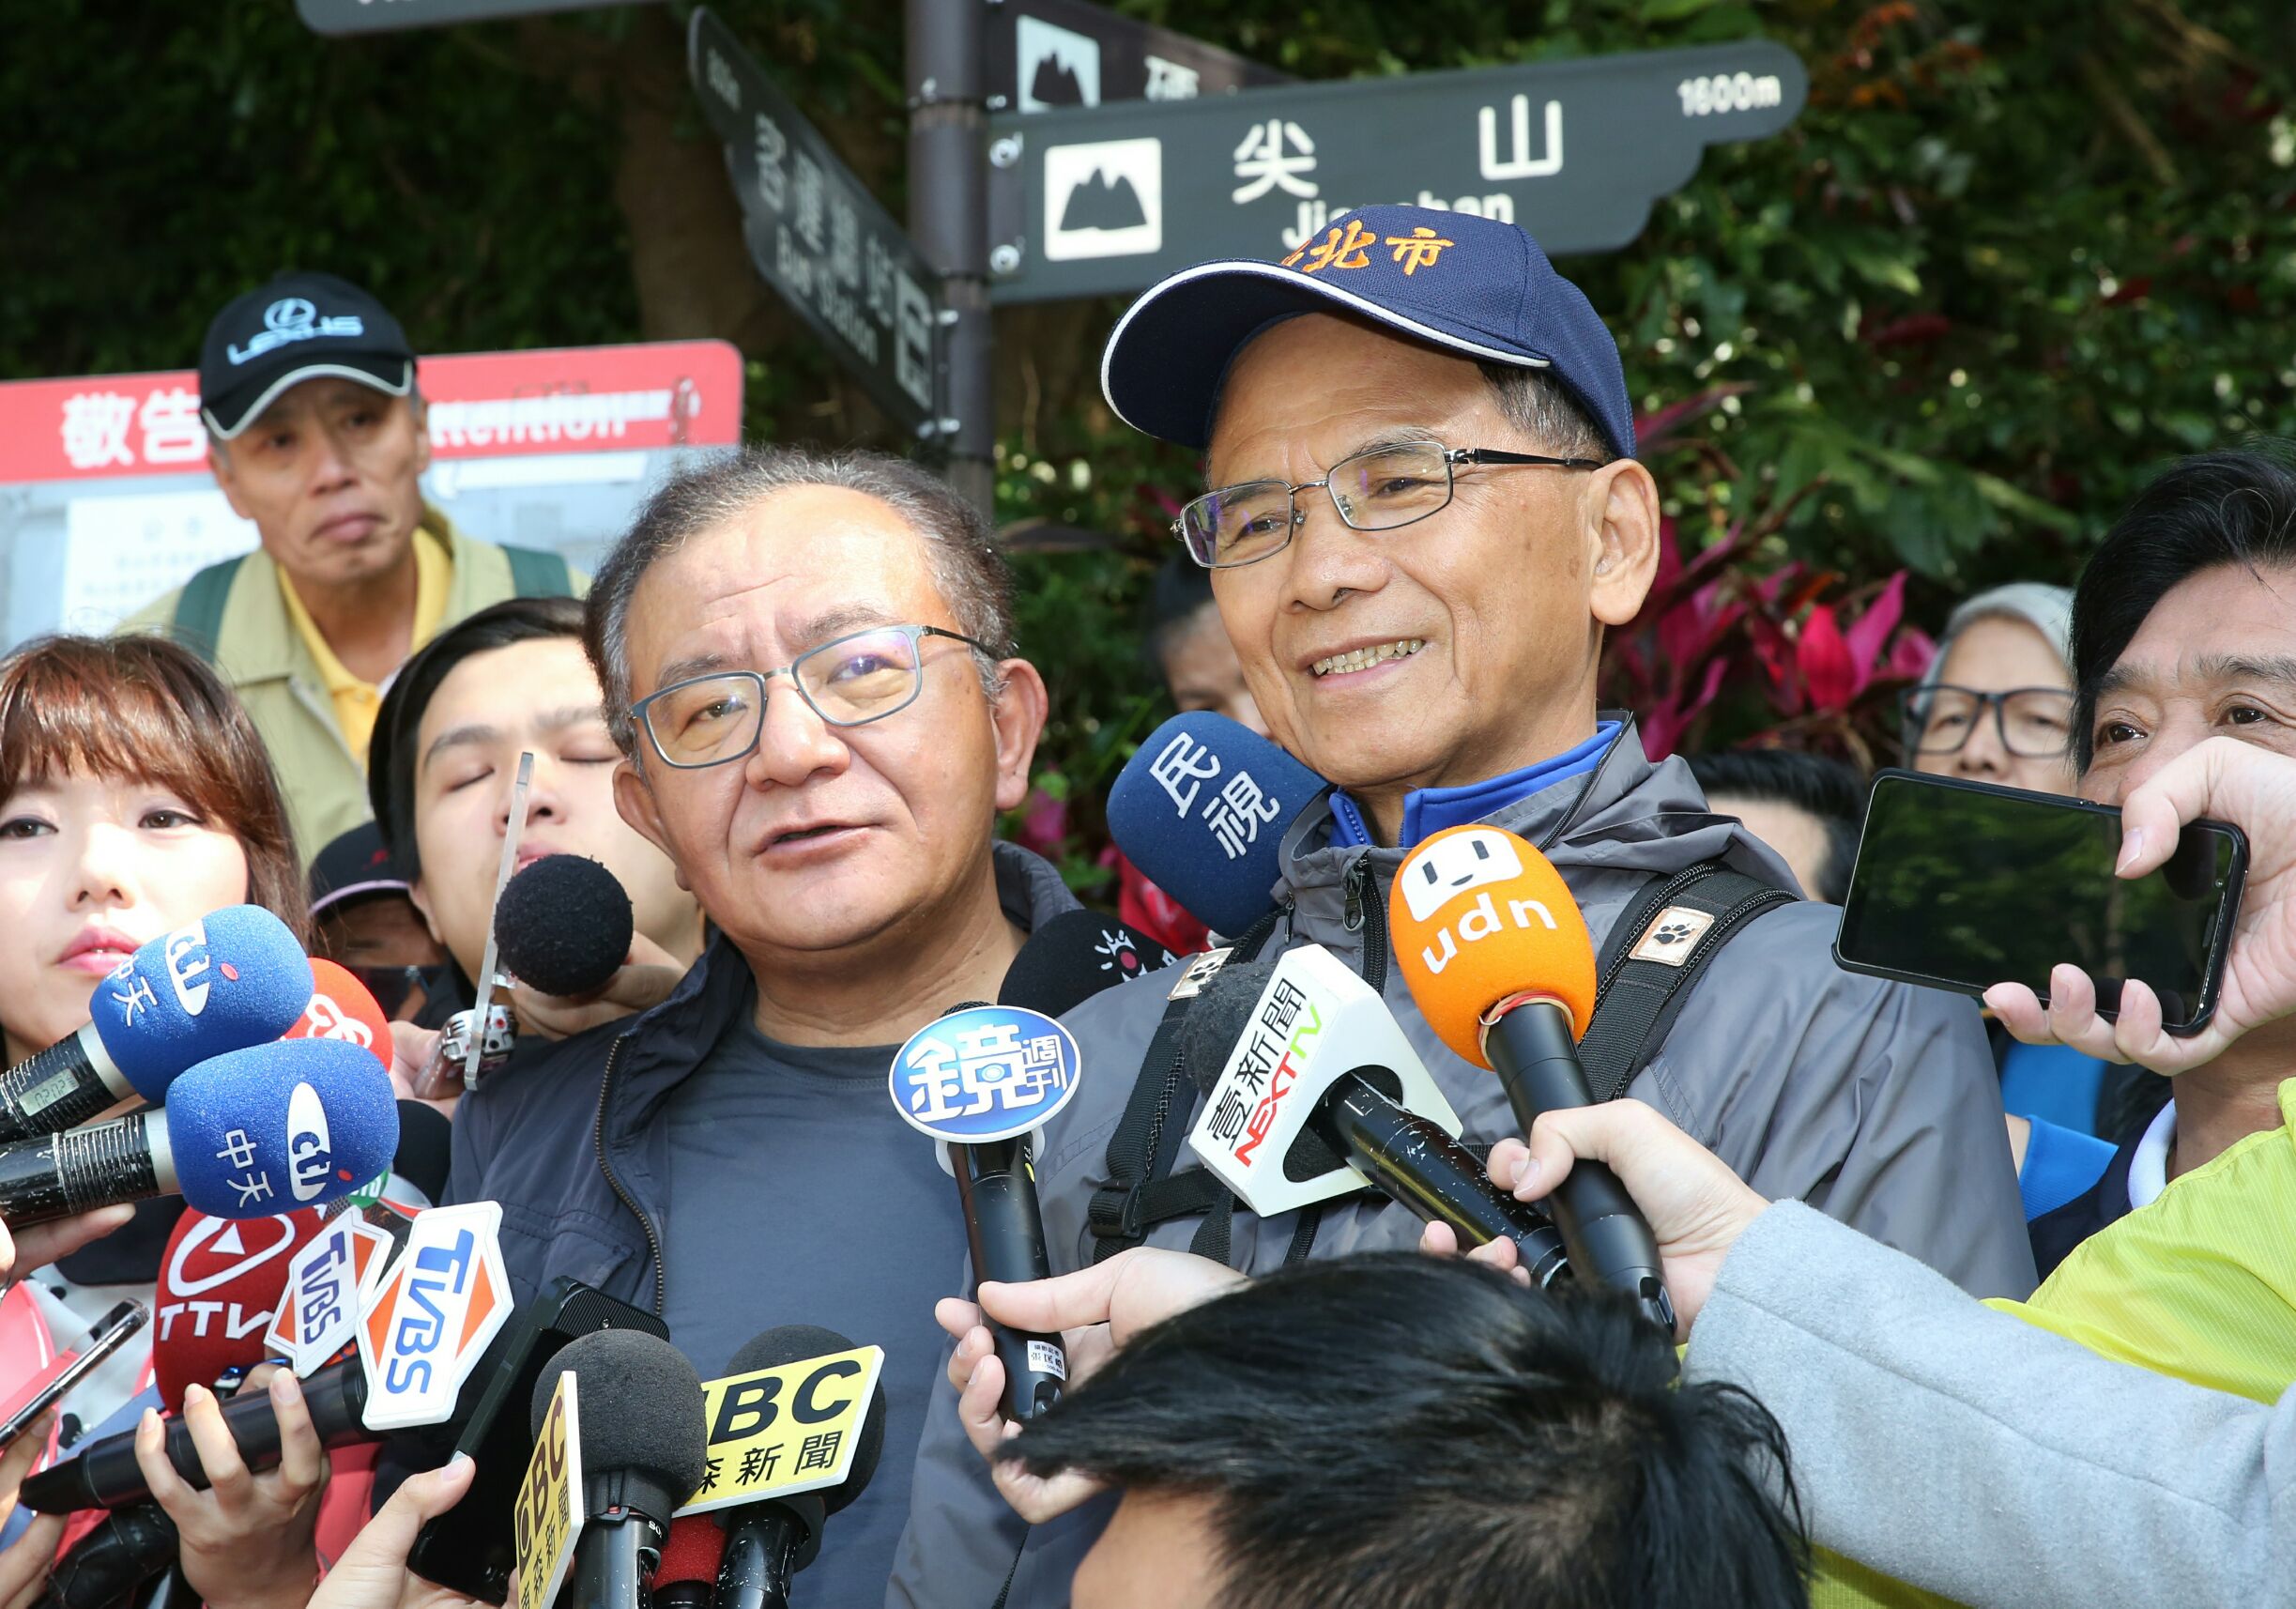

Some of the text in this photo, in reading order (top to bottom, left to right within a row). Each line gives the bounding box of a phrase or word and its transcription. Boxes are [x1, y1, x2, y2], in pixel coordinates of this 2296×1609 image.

[1676, 70, 1782, 117] 1600m
[1231, 94, 1565, 205] 尖山
[1281, 219, 1455, 276] 北市
[61, 388, 209, 468] 敬告
[1149, 731, 1280, 860] 民視
[1421, 892, 1558, 974] udn
[1207, 977, 1307, 1151] 壹新聞
[217, 1129, 274, 1208] 中天
[160, 1300, 274, 1341] TTV
[301, 1231, 346, 1345] TVBS
[385, 1228, 475, 1395] TVBS
[702, 1359, 862, 1447] BC
